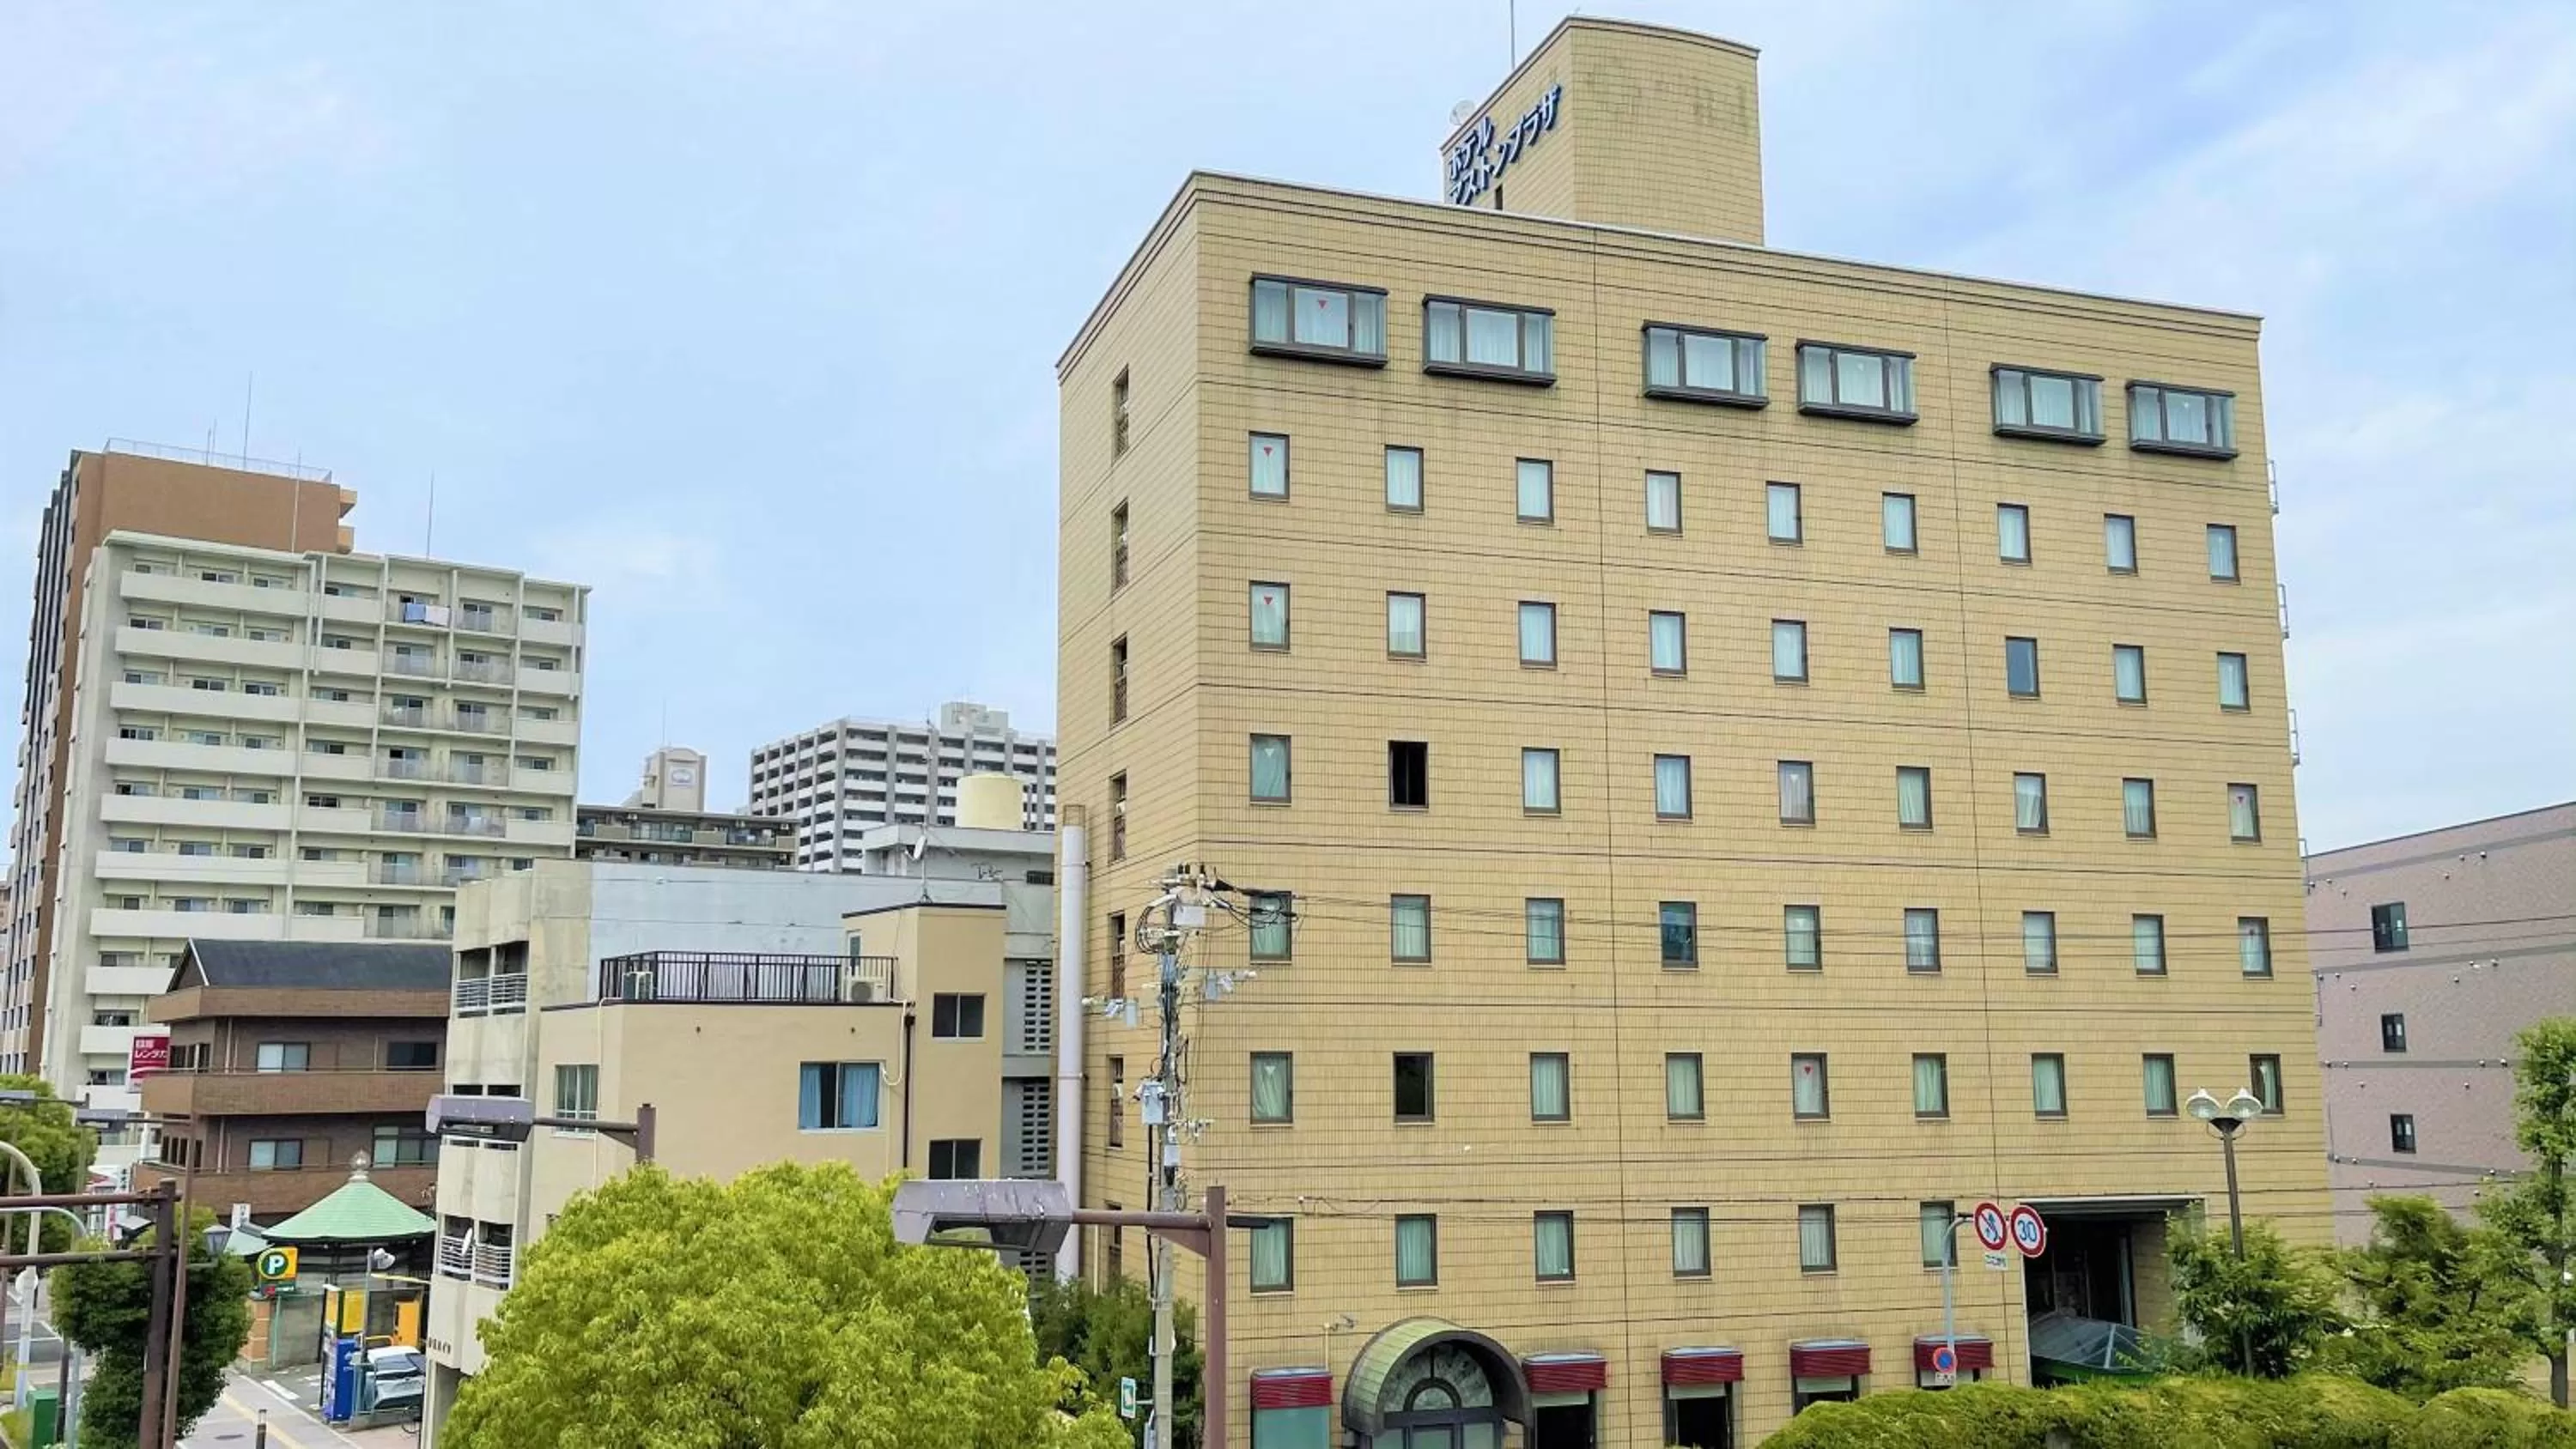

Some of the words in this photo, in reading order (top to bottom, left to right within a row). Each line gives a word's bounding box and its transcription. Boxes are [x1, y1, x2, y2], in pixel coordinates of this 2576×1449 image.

[1449, 116, 1494, 181] ホテル
[2018, 1220, 2038, 1242] 30
[268, 1255, 285, 1275] P
